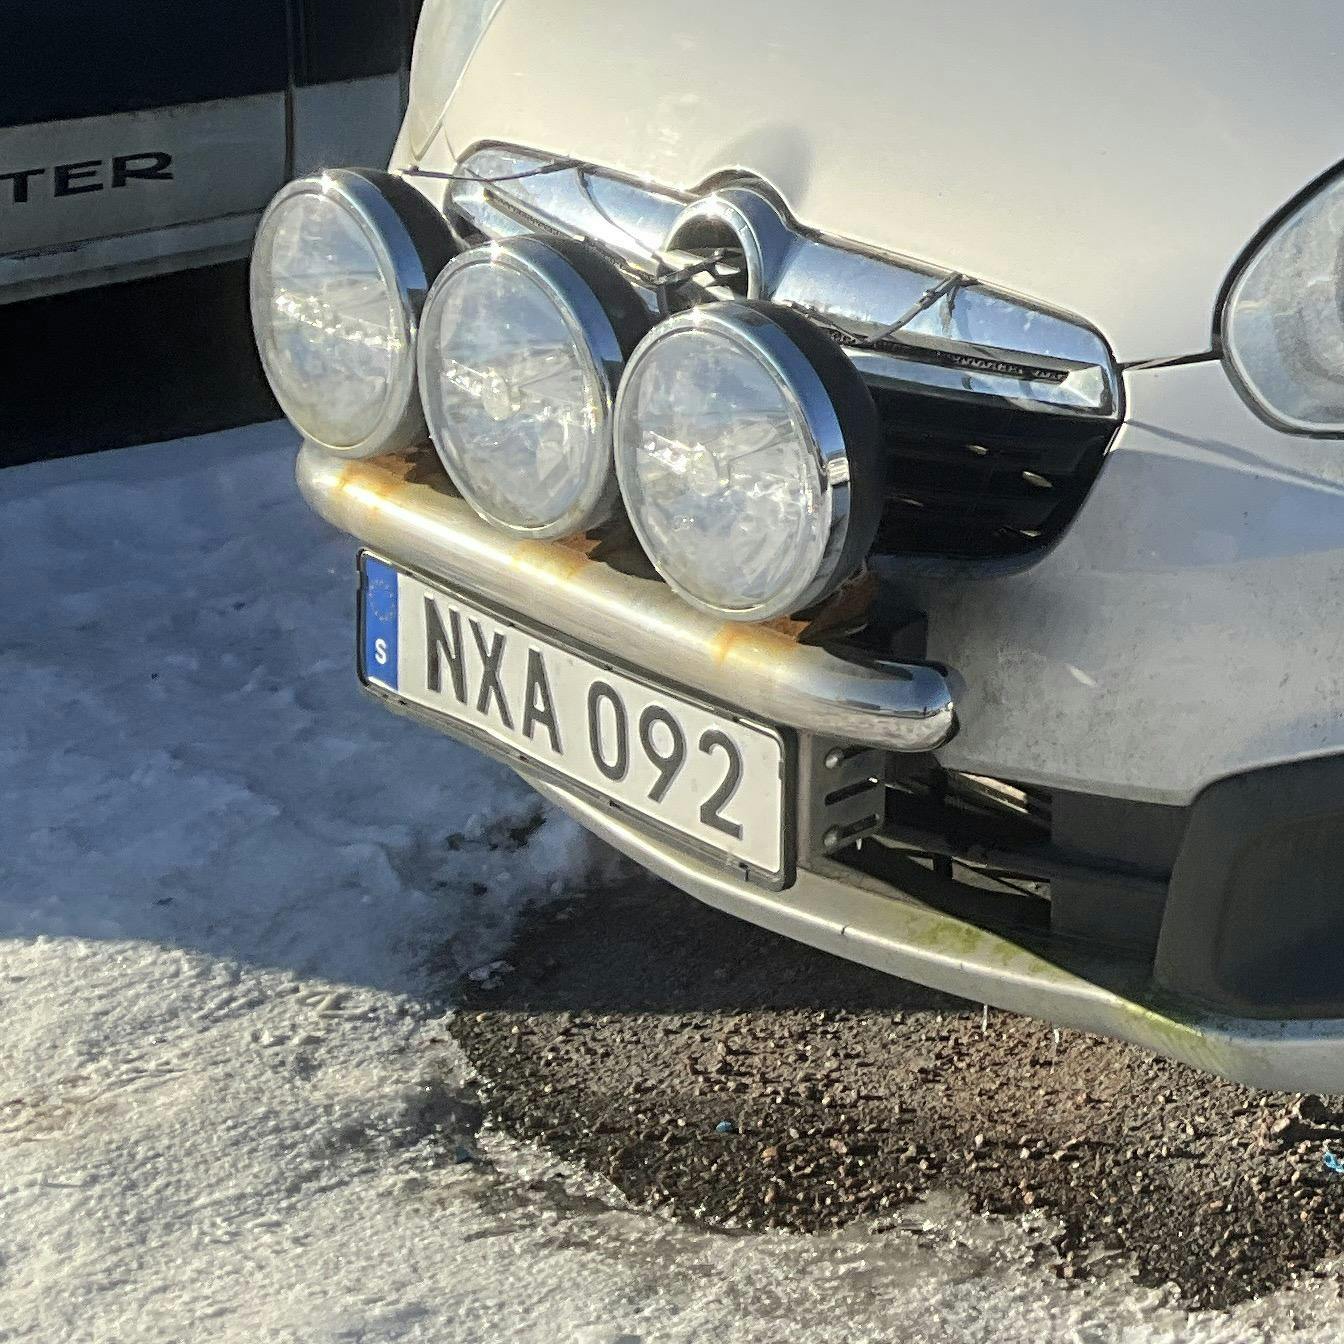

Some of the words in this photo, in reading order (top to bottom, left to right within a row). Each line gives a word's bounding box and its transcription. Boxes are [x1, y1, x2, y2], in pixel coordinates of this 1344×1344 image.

[374, 638, 387, 665] S
[424, 594, 564, 755] NXA
[587, 680, 745, 840] 092
